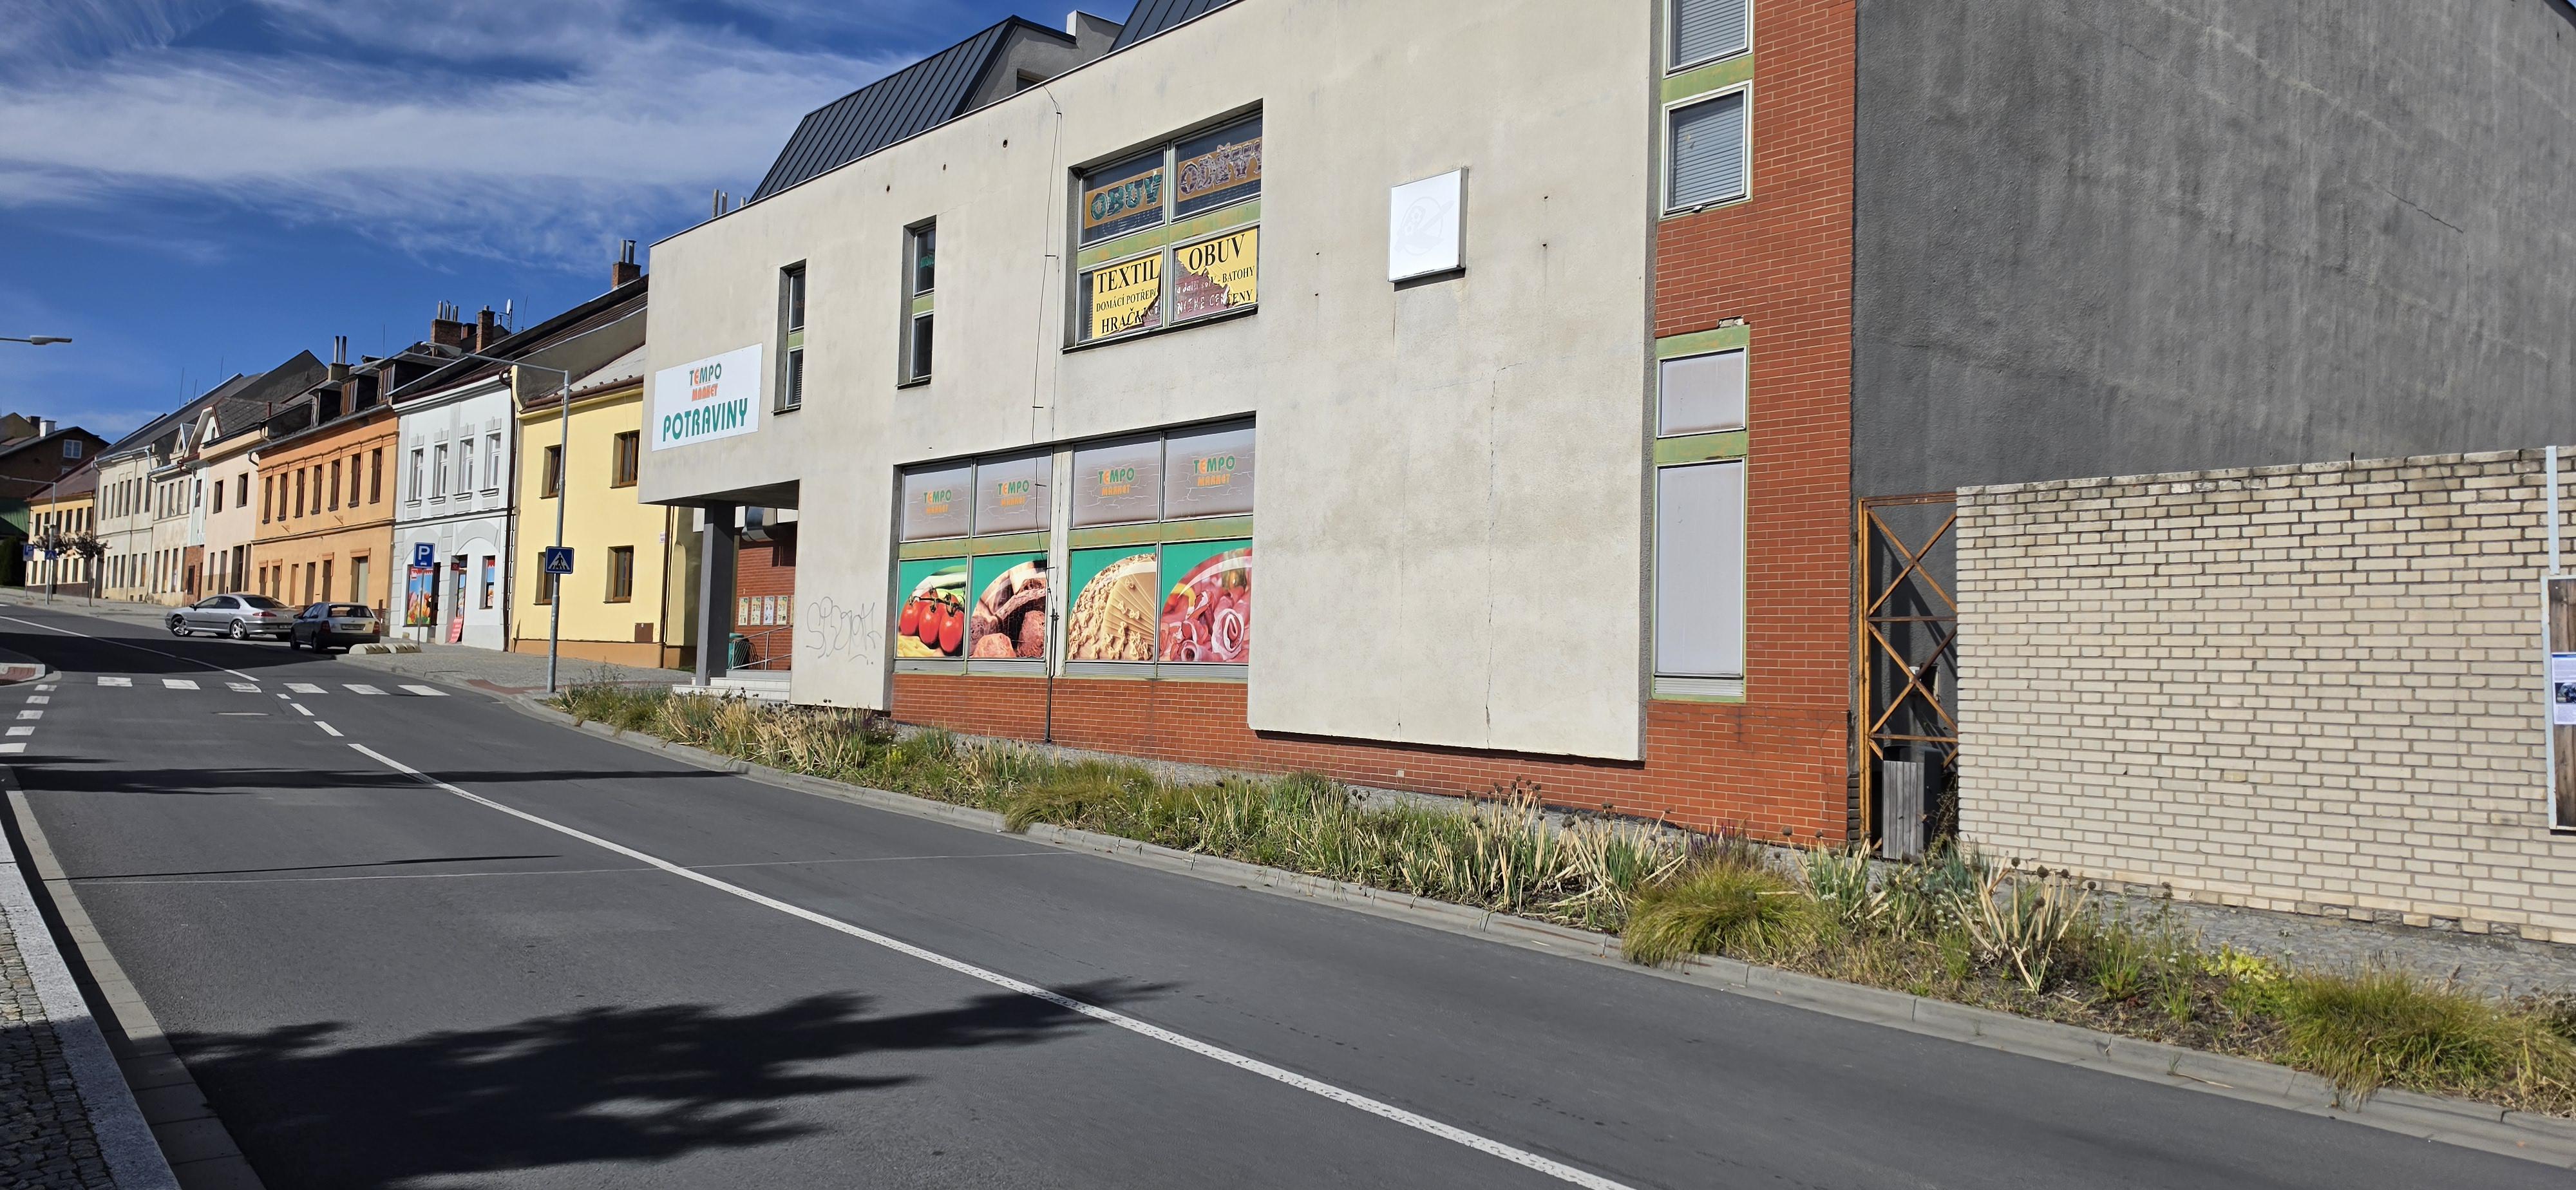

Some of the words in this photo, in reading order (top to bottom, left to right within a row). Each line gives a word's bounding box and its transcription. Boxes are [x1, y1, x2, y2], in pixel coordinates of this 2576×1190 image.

[1091, 173, 1163, 221] OBUV
[1189, 234, 1245, 270] OBUV
[1097, 259, 1159, 294] TEXTIL
[1222, 266, 1255, 283] BATOHY
[1096, 294, 1124, 312] DOMÁCÍ
[690, 363, 722, 386] TEMPO
[663, 398, 748, 442] POTRAVINY
[1193, 455, 1235, 474] TEMPO
[1098, 468, 1135, 484] TEMPO
[998, 480, 1029, 495] TEMPO
[923, 489, 952, 505] TEMPO
[418, 545, 430, 560] P
